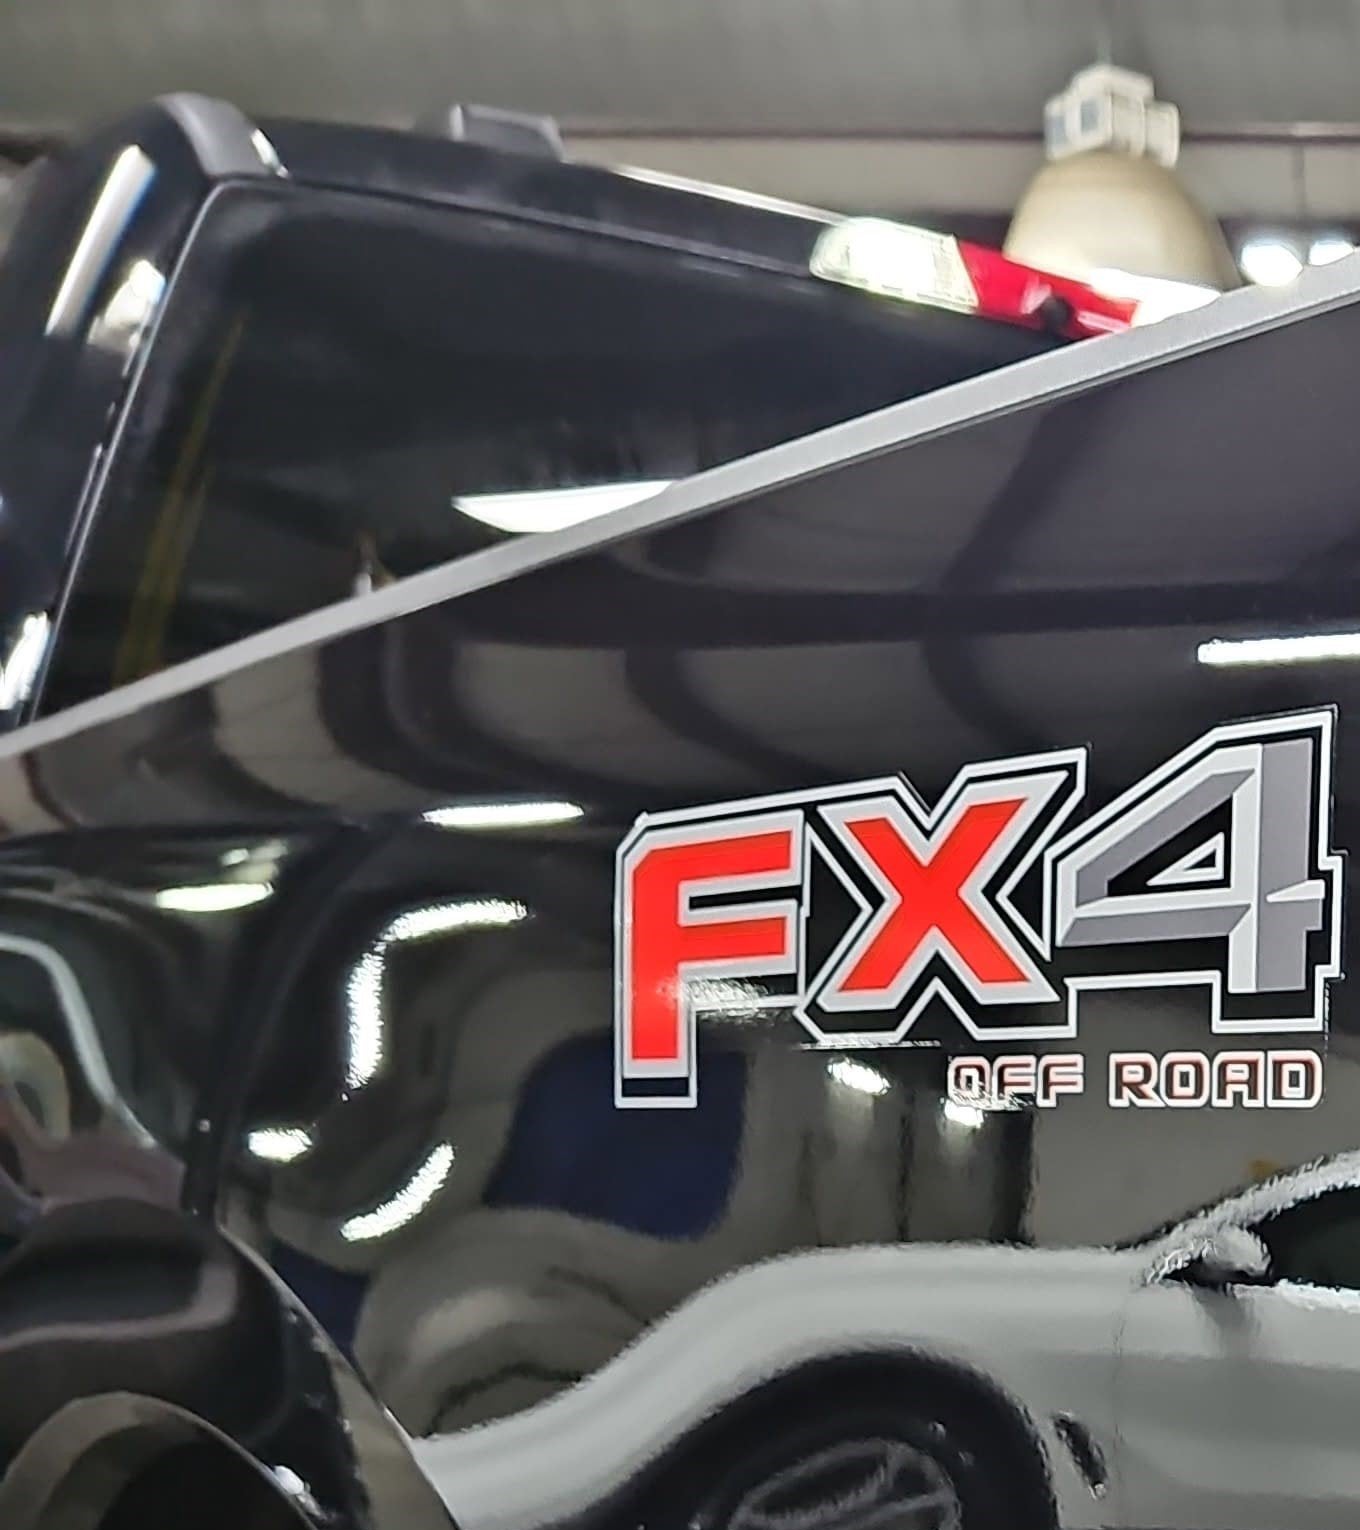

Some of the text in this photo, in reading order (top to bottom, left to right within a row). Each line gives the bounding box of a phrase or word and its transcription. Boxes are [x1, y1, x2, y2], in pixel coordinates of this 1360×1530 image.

[613, 704, 1347, 1109] FX4
[947, 1050, 1325, 1110] OFF ROAD
